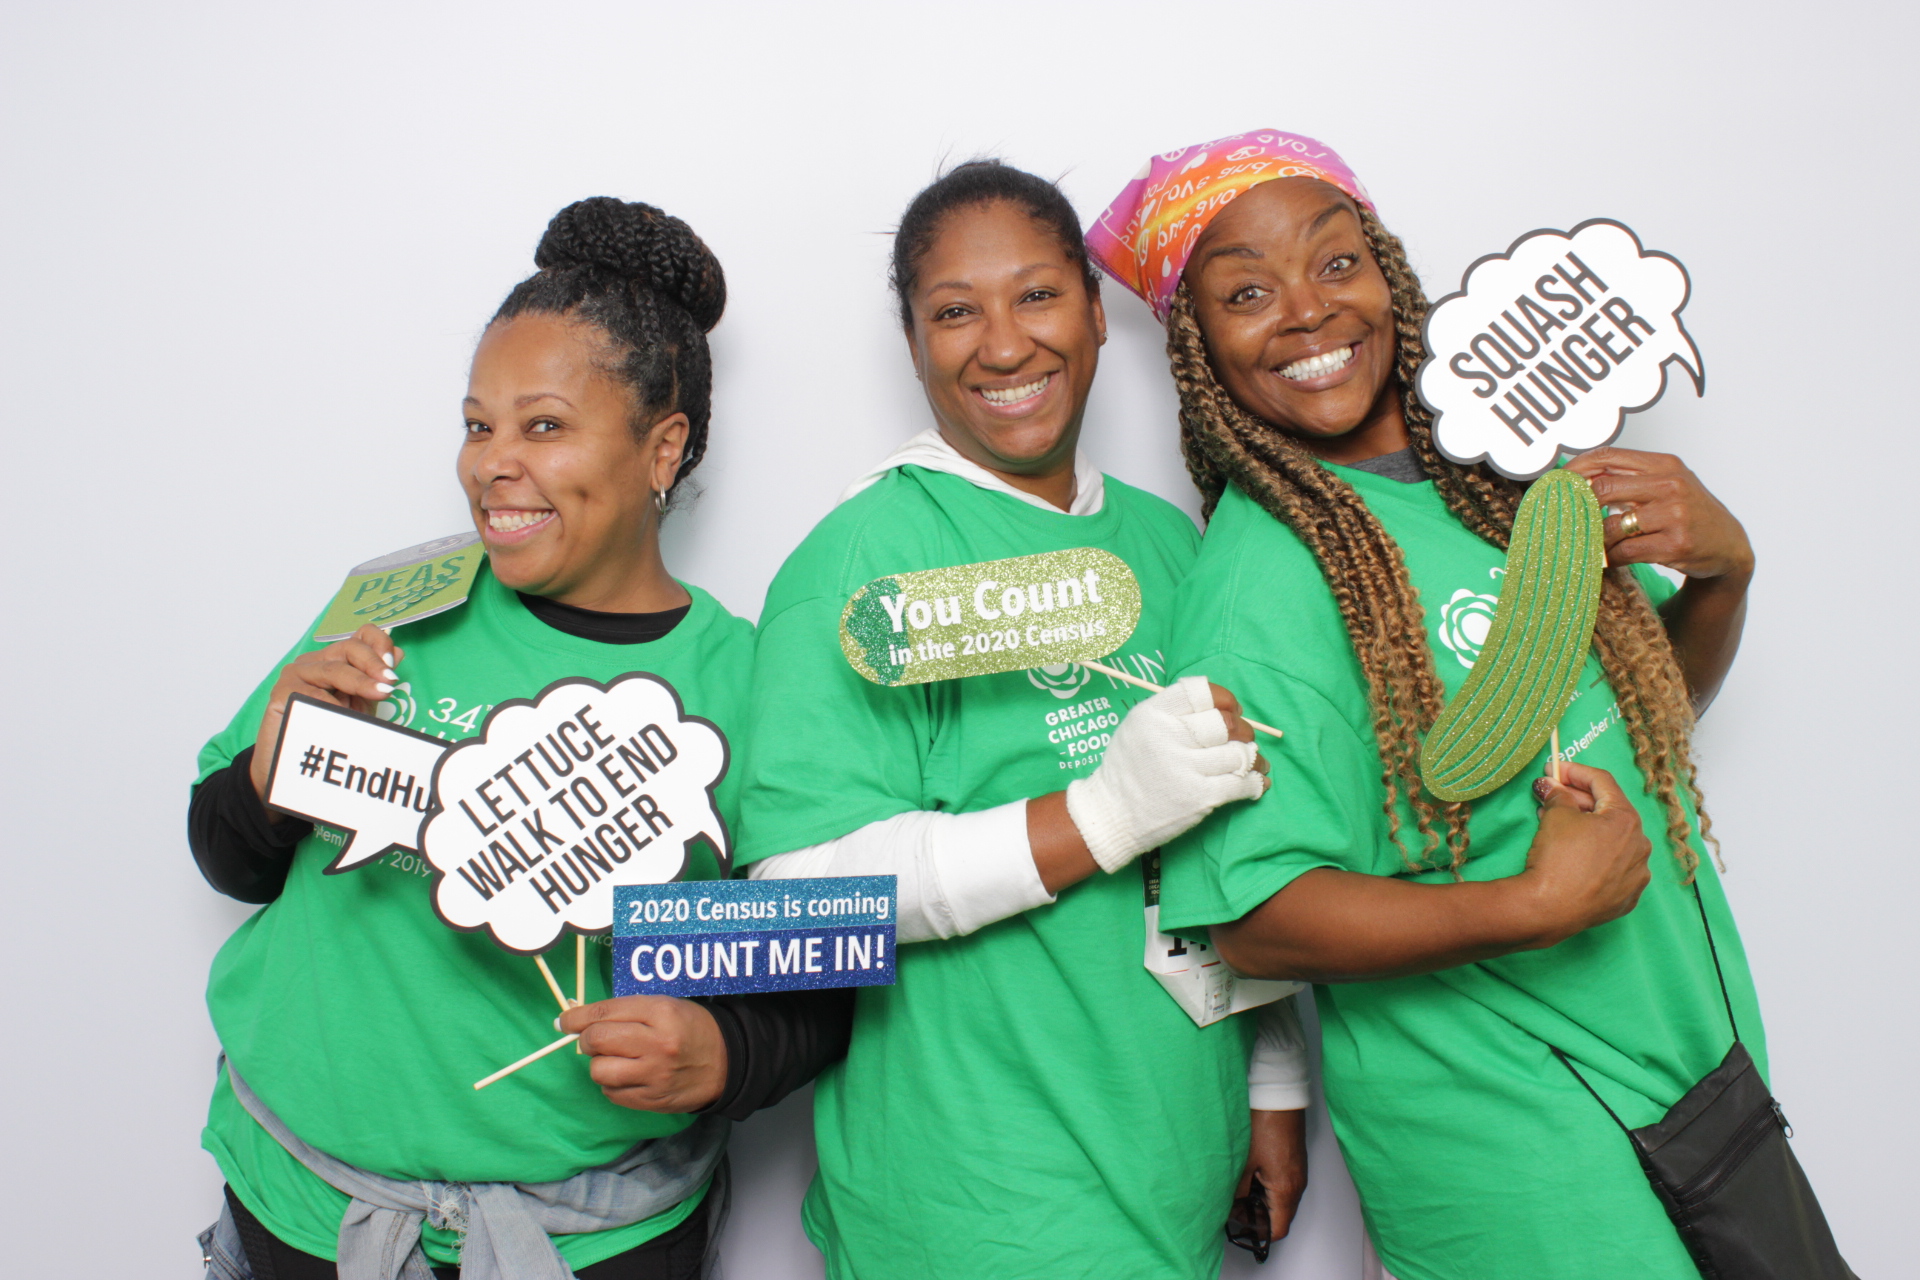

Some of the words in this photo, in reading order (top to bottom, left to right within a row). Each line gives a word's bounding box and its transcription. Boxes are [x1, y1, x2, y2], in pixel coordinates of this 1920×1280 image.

[1448, 250, 1610, 399] SQUASH
[1489, 296, 1657, 447] HUNGER
[353, 555, 466, 603] PEAS
[878, 592, 962, 634] You
[974, 568, 1102, 621] Count
[888, 643, 914, 666] in
[916, 637, 956, 661] the
[961, 628, 1020, 657] 2020
[1025, 618, 1107, 647] Census
[1045, 696, 1112, 726] GREATER
[1048, 712, 1119, 744] CHICAGO
[1067, 732, 1111, 757] FOOD
[458, 703, 616, 838] LETTUCE
[456, 807, 566, 902] WALK
[550, 775, 609, 830] TO
[595, 722, 679, 801] END
[527, 792, 675, 914] HUNGER
[628, 899, 690, 924] 2020
[696, 897, 777, 921] Census
[783, 893, 802, 918] is
[807, 891, 890, 921] coming
[630, 940, 760, 983] COUNT
[768, 936, 823, 976] ME
[834, 933, 886, 972] IN!
